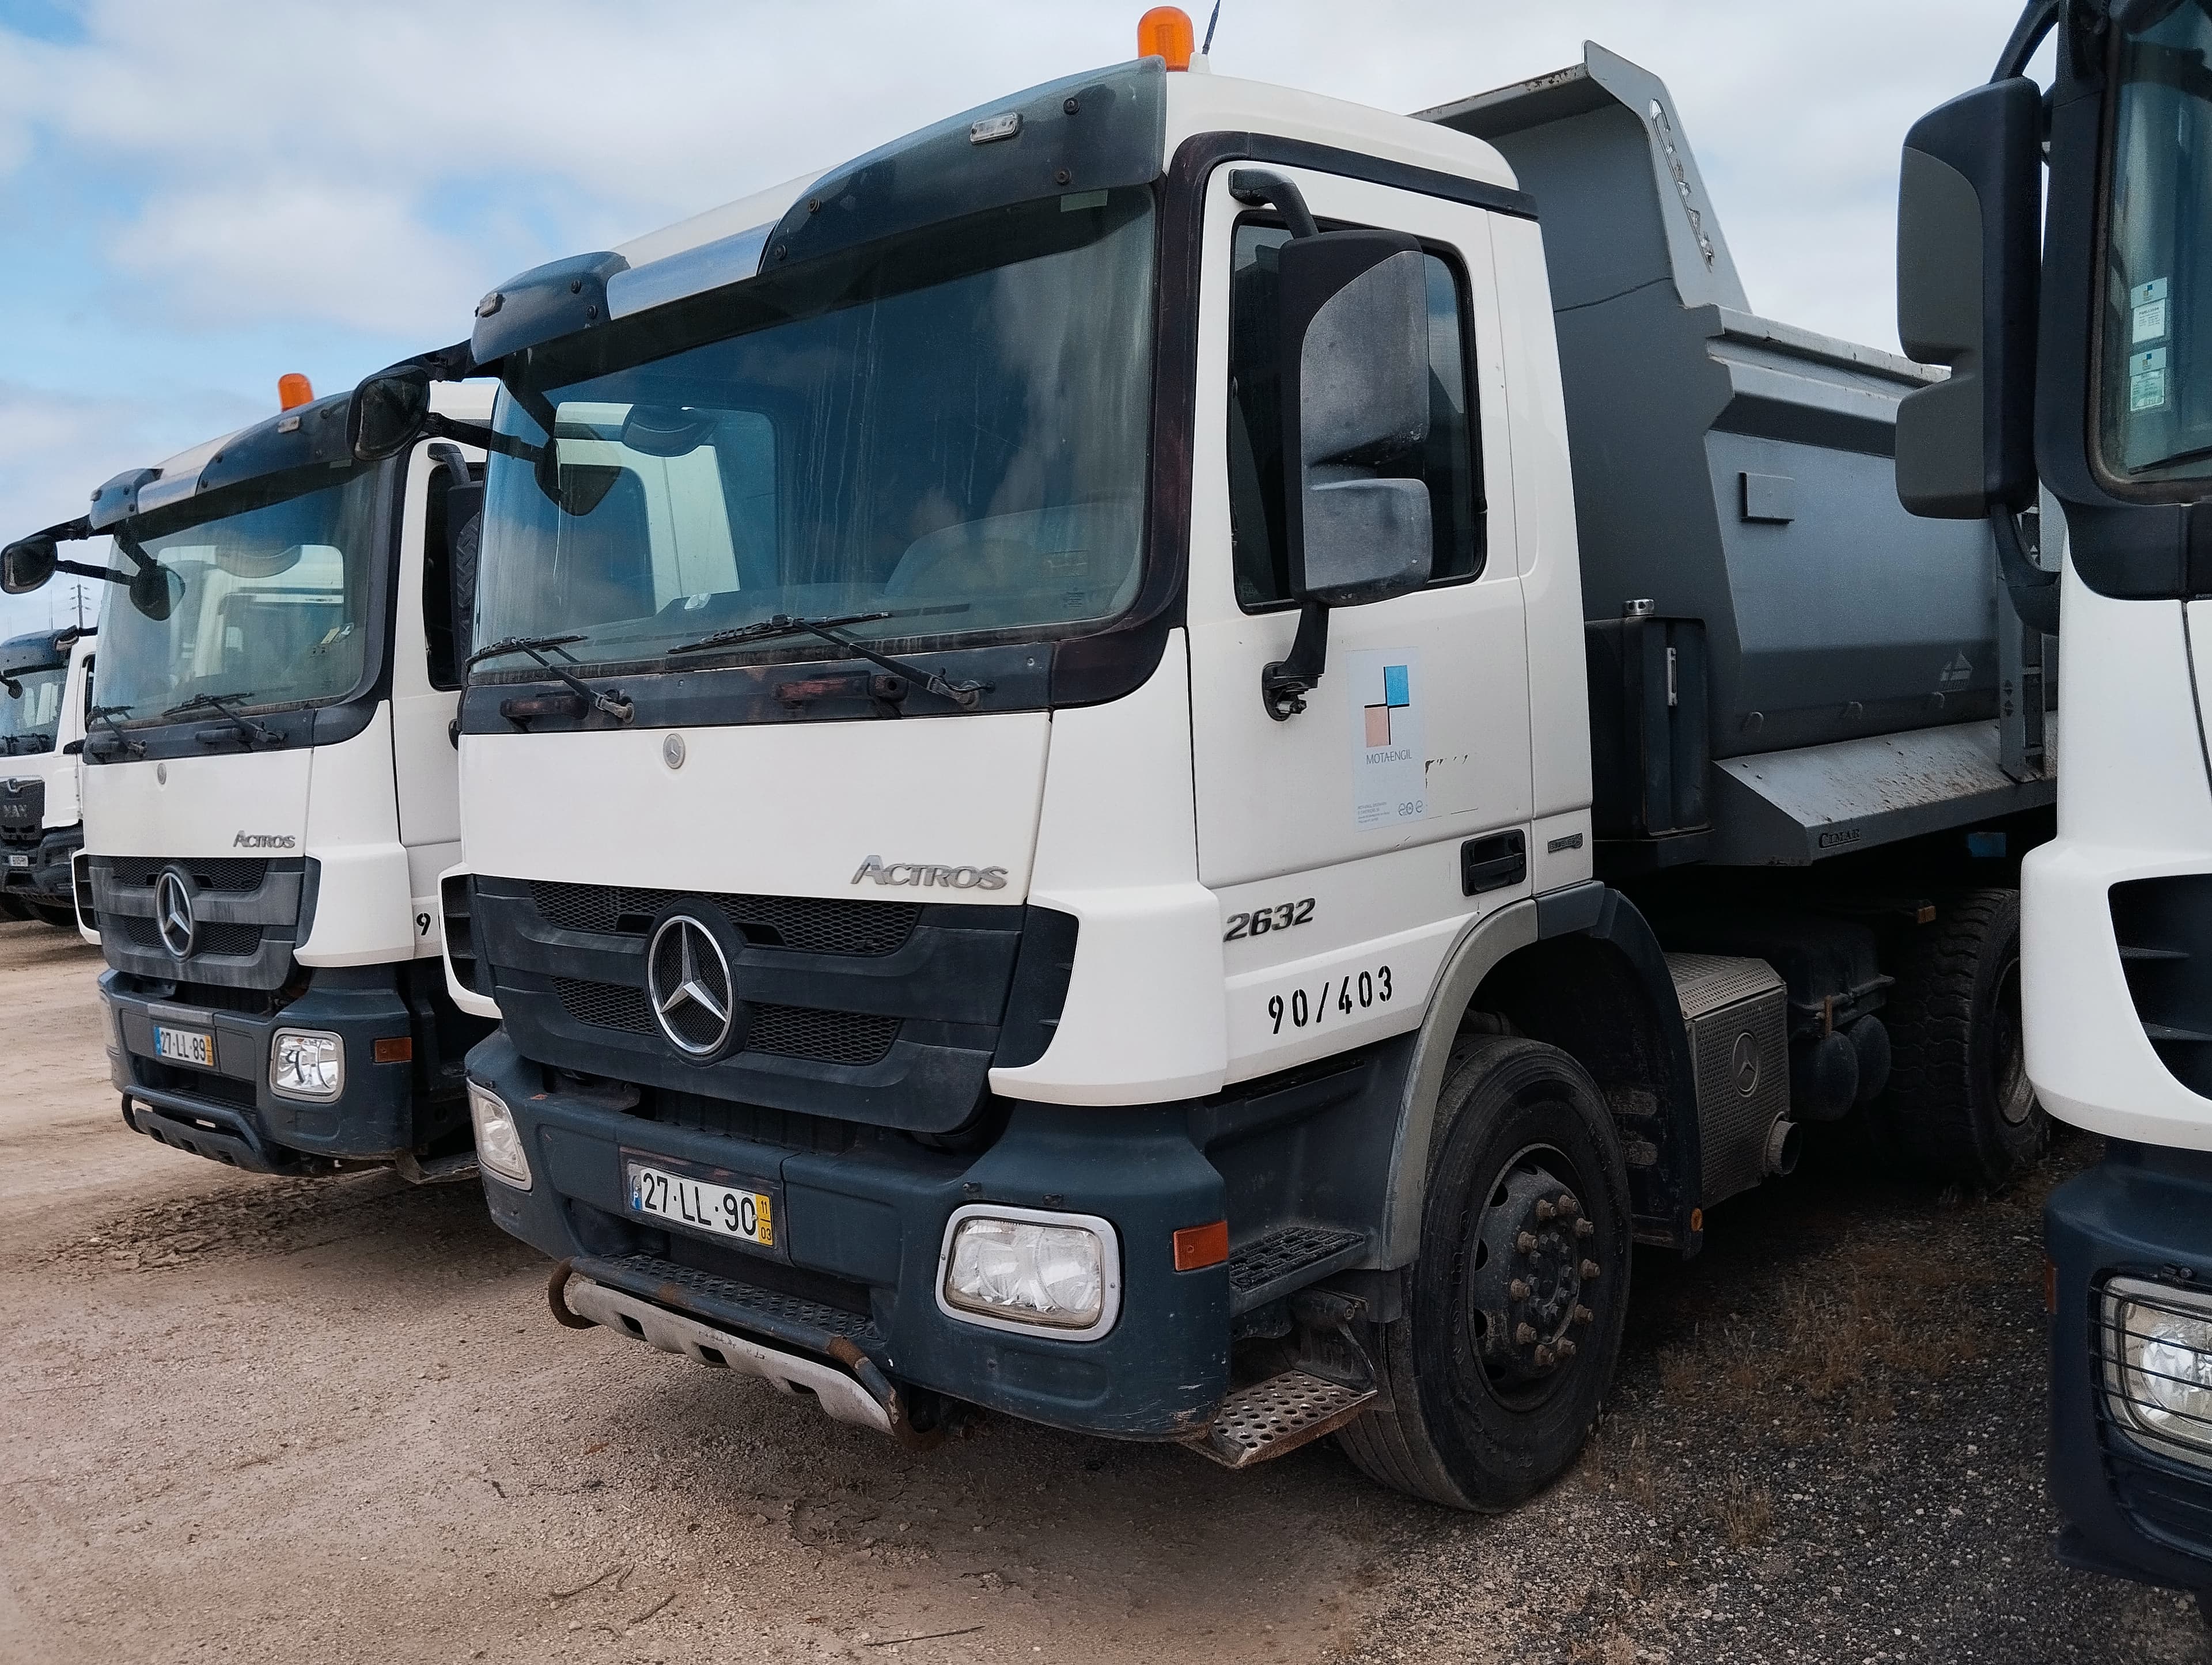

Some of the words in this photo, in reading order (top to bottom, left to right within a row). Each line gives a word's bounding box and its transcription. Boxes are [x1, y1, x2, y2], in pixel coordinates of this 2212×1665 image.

[233, 829, 296, 849] ACTROS
[850, 854, 1009, 890] ACTROS
[416, 912, 440, 936] 9
[1223, 897, 1316, 943] 2632
[1268, 965, 1393, 1035] 90/403
[760, 1200, 768, 1215] 11
[760, 1226, 772, 1241] 03
